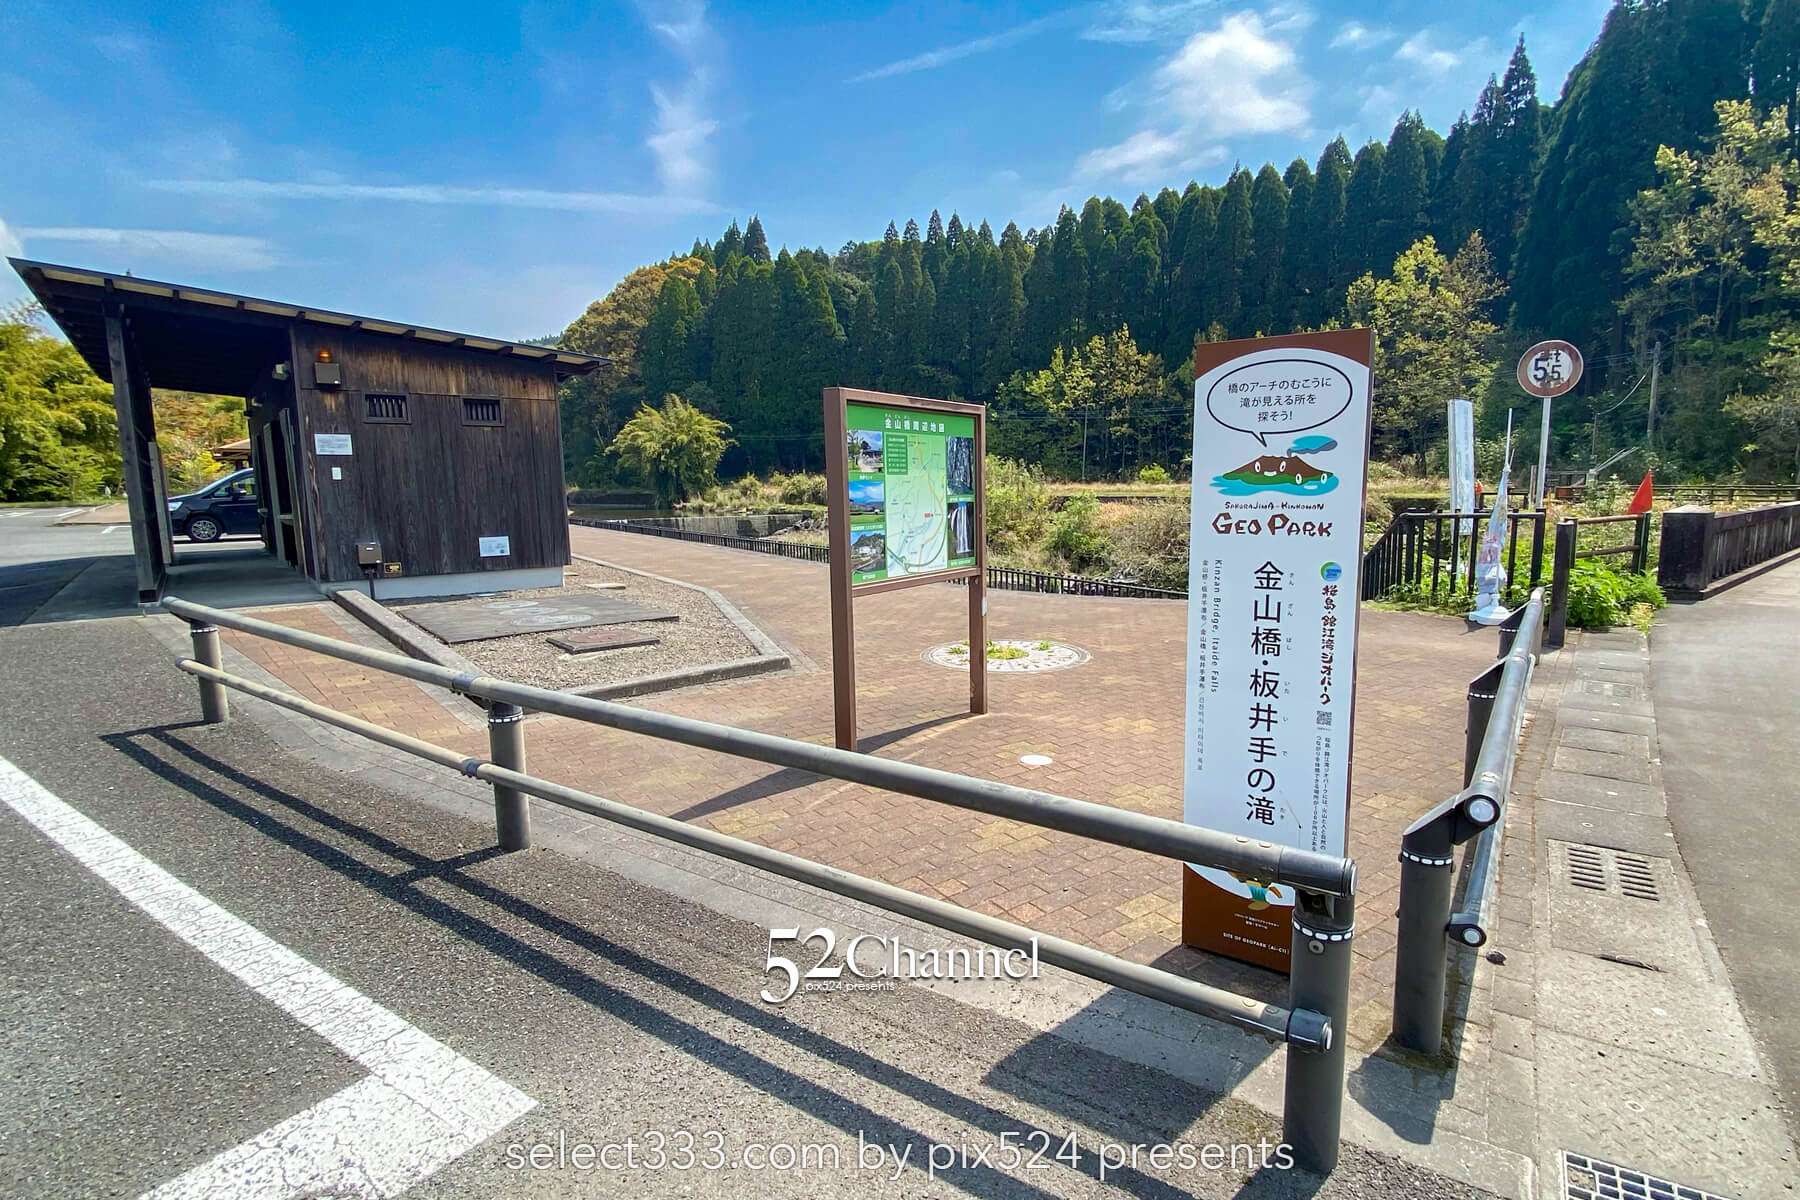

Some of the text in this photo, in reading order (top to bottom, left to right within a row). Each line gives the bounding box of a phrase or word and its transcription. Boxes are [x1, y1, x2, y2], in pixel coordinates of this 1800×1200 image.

[1228, 376, 1332, 394] 橋のアーチのむこうに
[1239, 393, 1317, 409] 滝が見える所を
[1211, 512, 1333, 537] GEO PARK
[1214, 559, 1222, 593] Kinzan
[1210, 671, 1219, 693] Falls
[1246, 560, 1284, 825] 金山橋・板井手の滝
